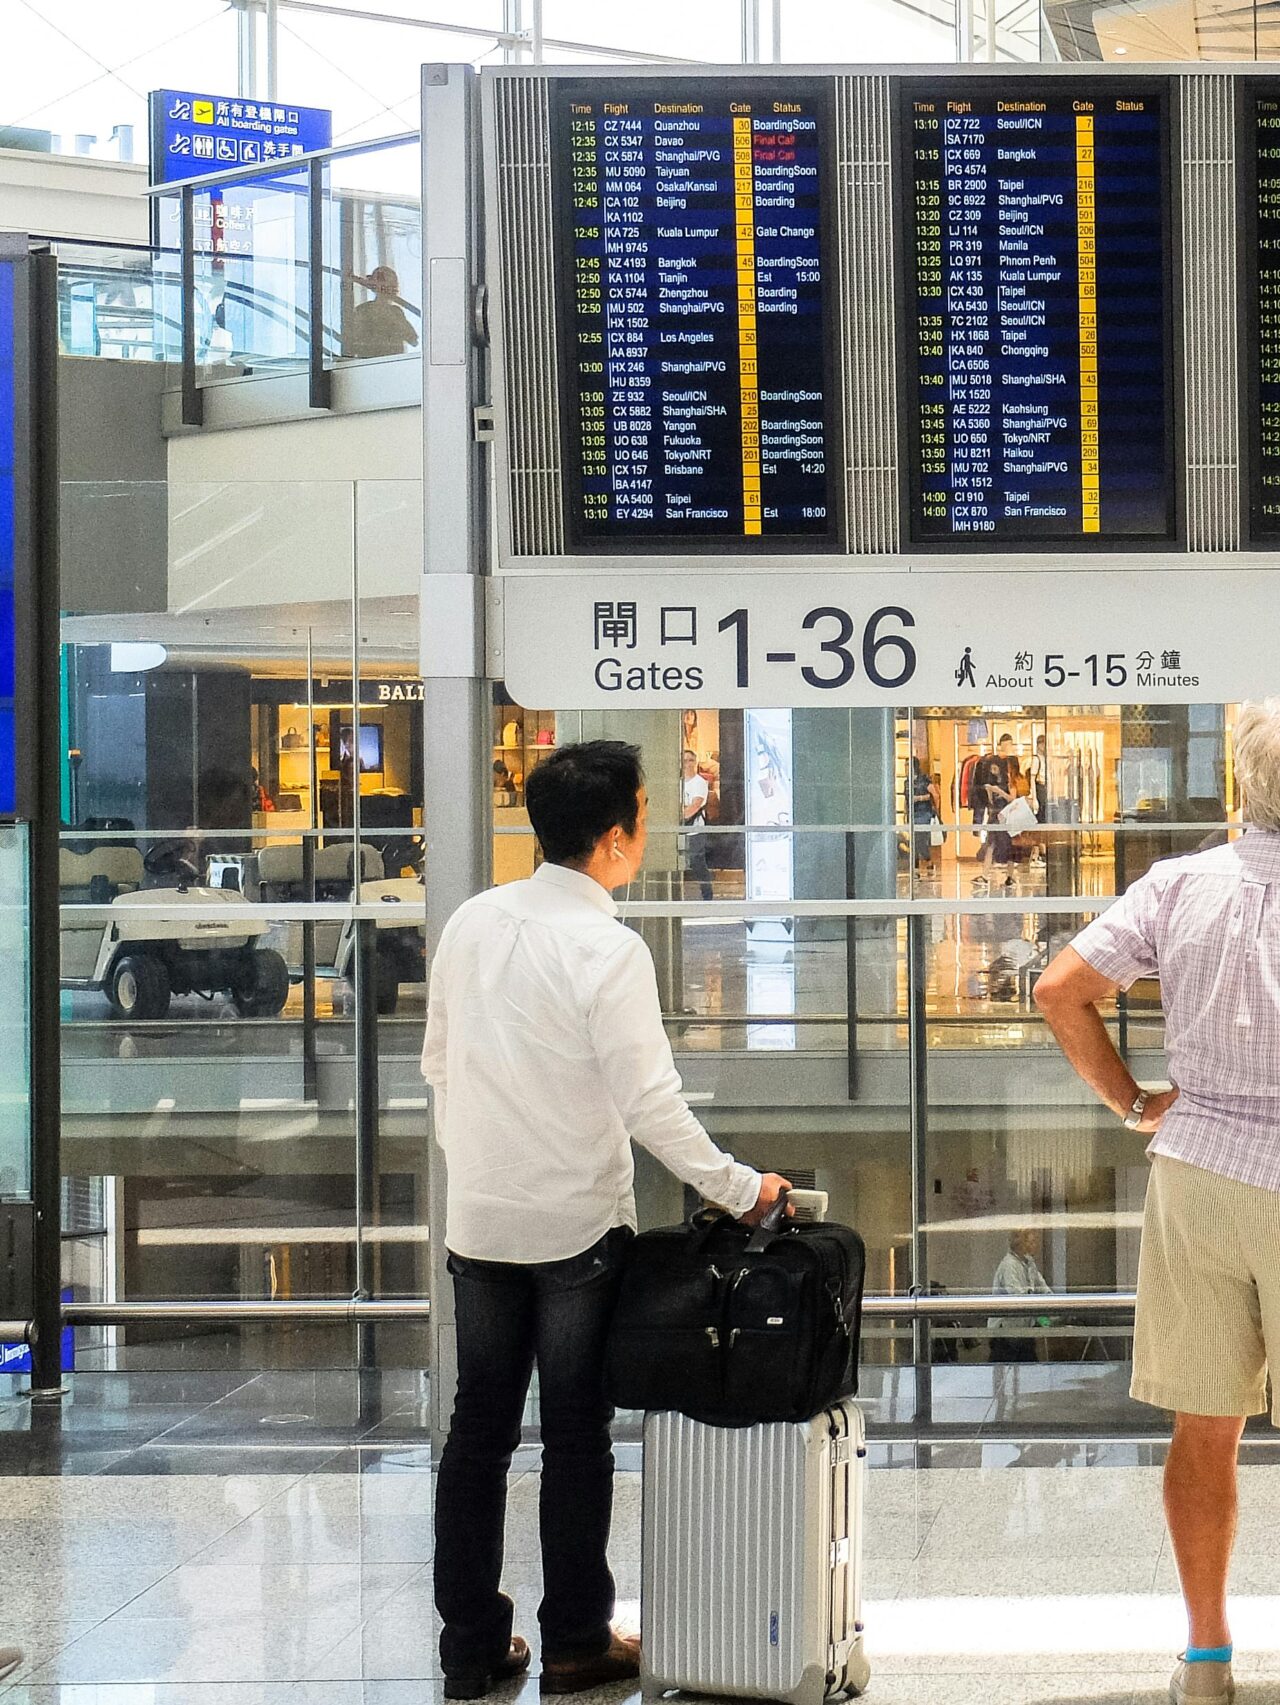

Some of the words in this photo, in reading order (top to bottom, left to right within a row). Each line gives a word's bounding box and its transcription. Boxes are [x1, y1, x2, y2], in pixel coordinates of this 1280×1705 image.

[570, 104, 591, 113] Time
[604, 104, 628, 115] Flight
[654, 104, 703, 113] Destination
[730, 103, 751, 112] Gate
[774, 103, 801, 112] Status
[217, 117, 229, 127] All
[232, 119, 272, 133] boarding
[274, 125, 298, 135] gates
[572, 121, 595, 131] 12:15
[604, 121, 618, 131] CZ
[621, 121, 641, 130] 7444
[655, 120, 699, 131] Quanzhou
[754, 119, 815, 132] BoardingSoon
[1258, 118, 1280, 127] 14:00
[915, 150, 938, 159] 13:15
[947, 150, 961, 159] CX
[964, 150, 980, 159] 669
[998, 149, 1036, 161] Bangkok
[575, 228, 598, 237] 12:45
[607, 228, 623, 237] KA
[623, 227, 639, 237] 725
[658, 227, 682, 237] Kuala
[685, 227, 718, 238] Lumpur
[757, 227, 777, 236] Gate
[780, 226, 814, 238] Change
[917, 241, 940, 251] 13:20
[950, 241, 963, 250] PR
[966, 241, 982, 250] 319
[1000, 240, 1028, 250] Manila
[577, 273, 600, 283] 12:50
[609, 273, 622, 283] KA
[625, 273, 644, 282] 1104
[659, 273, 687, 285] Tianjin
[758, 272, 772, 281] Est
[796, 272, 820, 281] 15:00
[918, 271, 941, 281] 13:30
[950, 271, 963, 280] AK
[967, 271, 982, 281] 135
[1000, 271, 1025, 280] Kuala
[1027, 272, 1061, 281] Lumpur
[923, 492, 946, 501] 14:00
[955, 492, 964, 501] CI
[967, 492, 983, 501] 910
[1004, 492, 1029, 501] Taipei
[584, 509, 607, 518] 13:10
[617, 509, 629, 518] EY
[633, 509, 653, 518] 4294
[666, 509, 683, 518] San
[686, 508, 728, 518] Francisco
[764, 508, 778, 517] Est
[803, 508, 825, 517] 18:00
[594, 602, 696, 649] 閘口
[595, 658, 703, 690] Gates
[719, 606, 916, 688] 1-36
[1015, 652, 1033, 671] 約
[1136, 650, 1180, 670] 分鐘
[986, 675, 1032, 687] About
[1045, 654, 1126, 687] 5-15
[1138, 674, 1199, 686] Minutes
